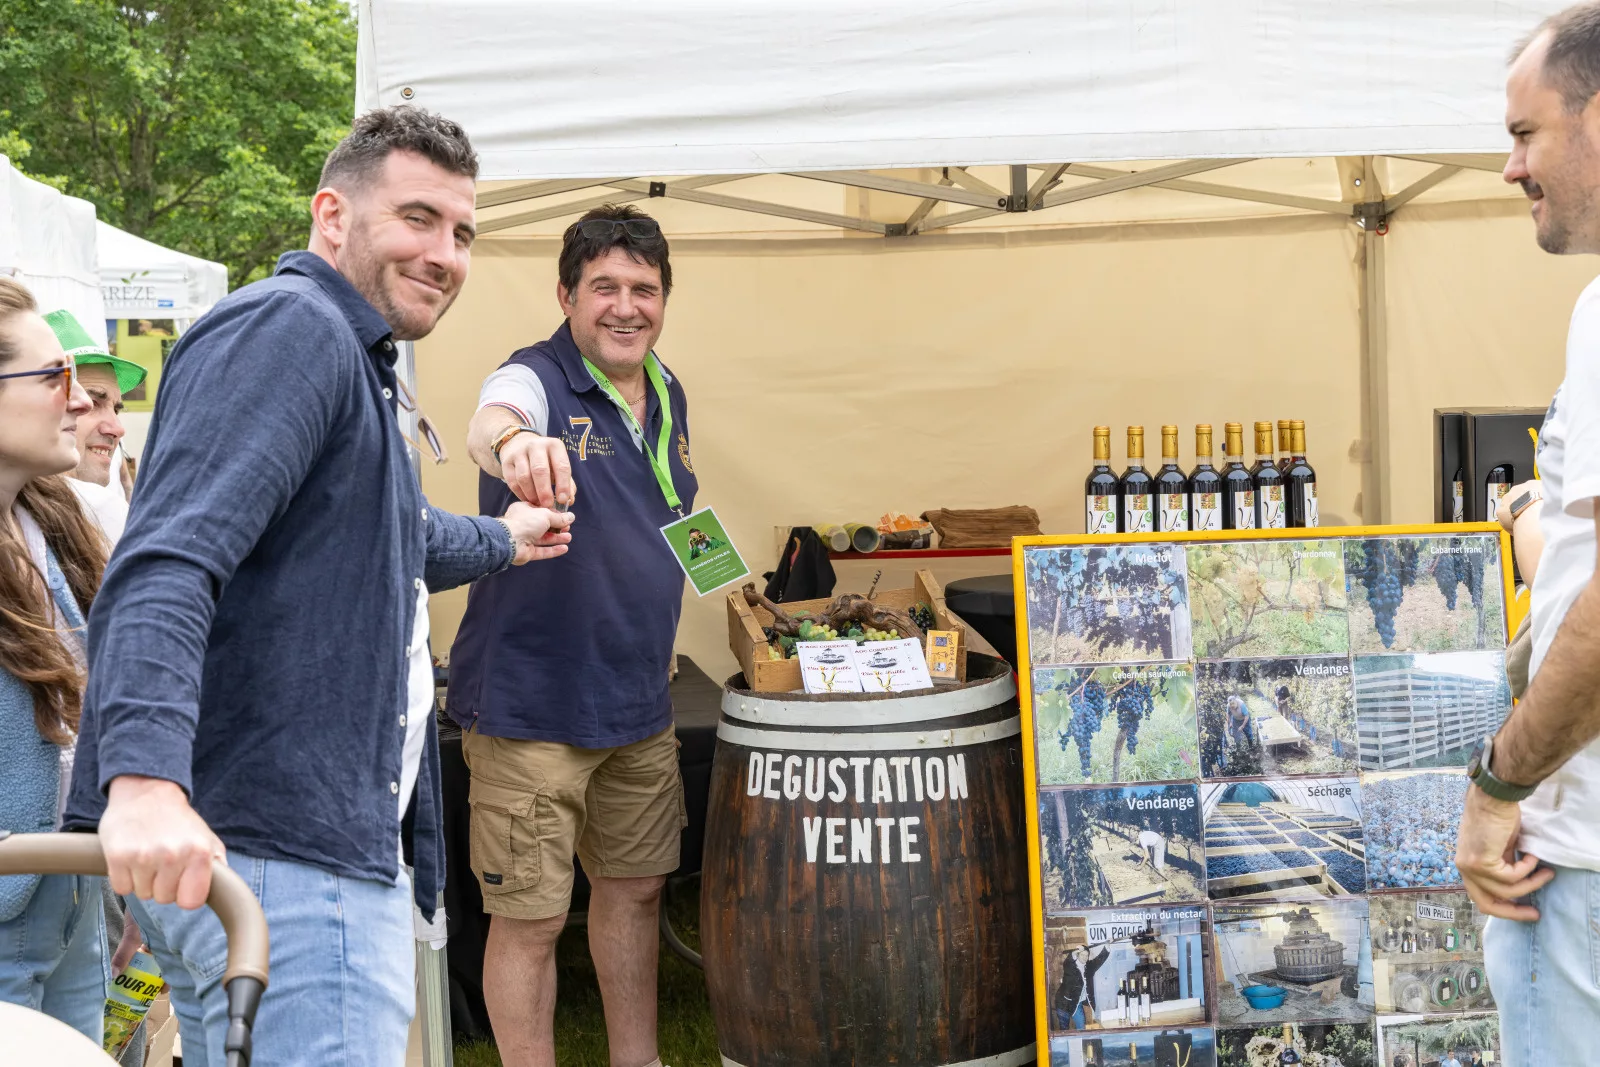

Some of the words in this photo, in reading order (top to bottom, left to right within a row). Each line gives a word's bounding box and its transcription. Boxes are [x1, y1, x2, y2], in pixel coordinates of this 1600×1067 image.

[568, 416, 592, 460] 7
[1135, 552, 1172, 564] Merlot
[1112, 670, 1147, 680] Cabernet
[1148, 669, 1186, 679] sauvignon
[1295, 664, 1349, 676] Vendange
[747, 752, 968, 804] DEGUSTATION
[1308, 786, 1352, 798] Séchage
[1127, 796, 1194, 811] Vendange
[803, 816, 921, 864] VENTE
[1111, 911, 1157, 922] Extraction
[1160, 910, 1172, 919] du
[1174, 910, 1202, 919] nectar
[1418, 906, 1430, 916] VIN
[1434, 908, 1454, 920] PAILLE
[1090, 927, 1107, 940] VIN
[112, 974, 145, 992] OUR
